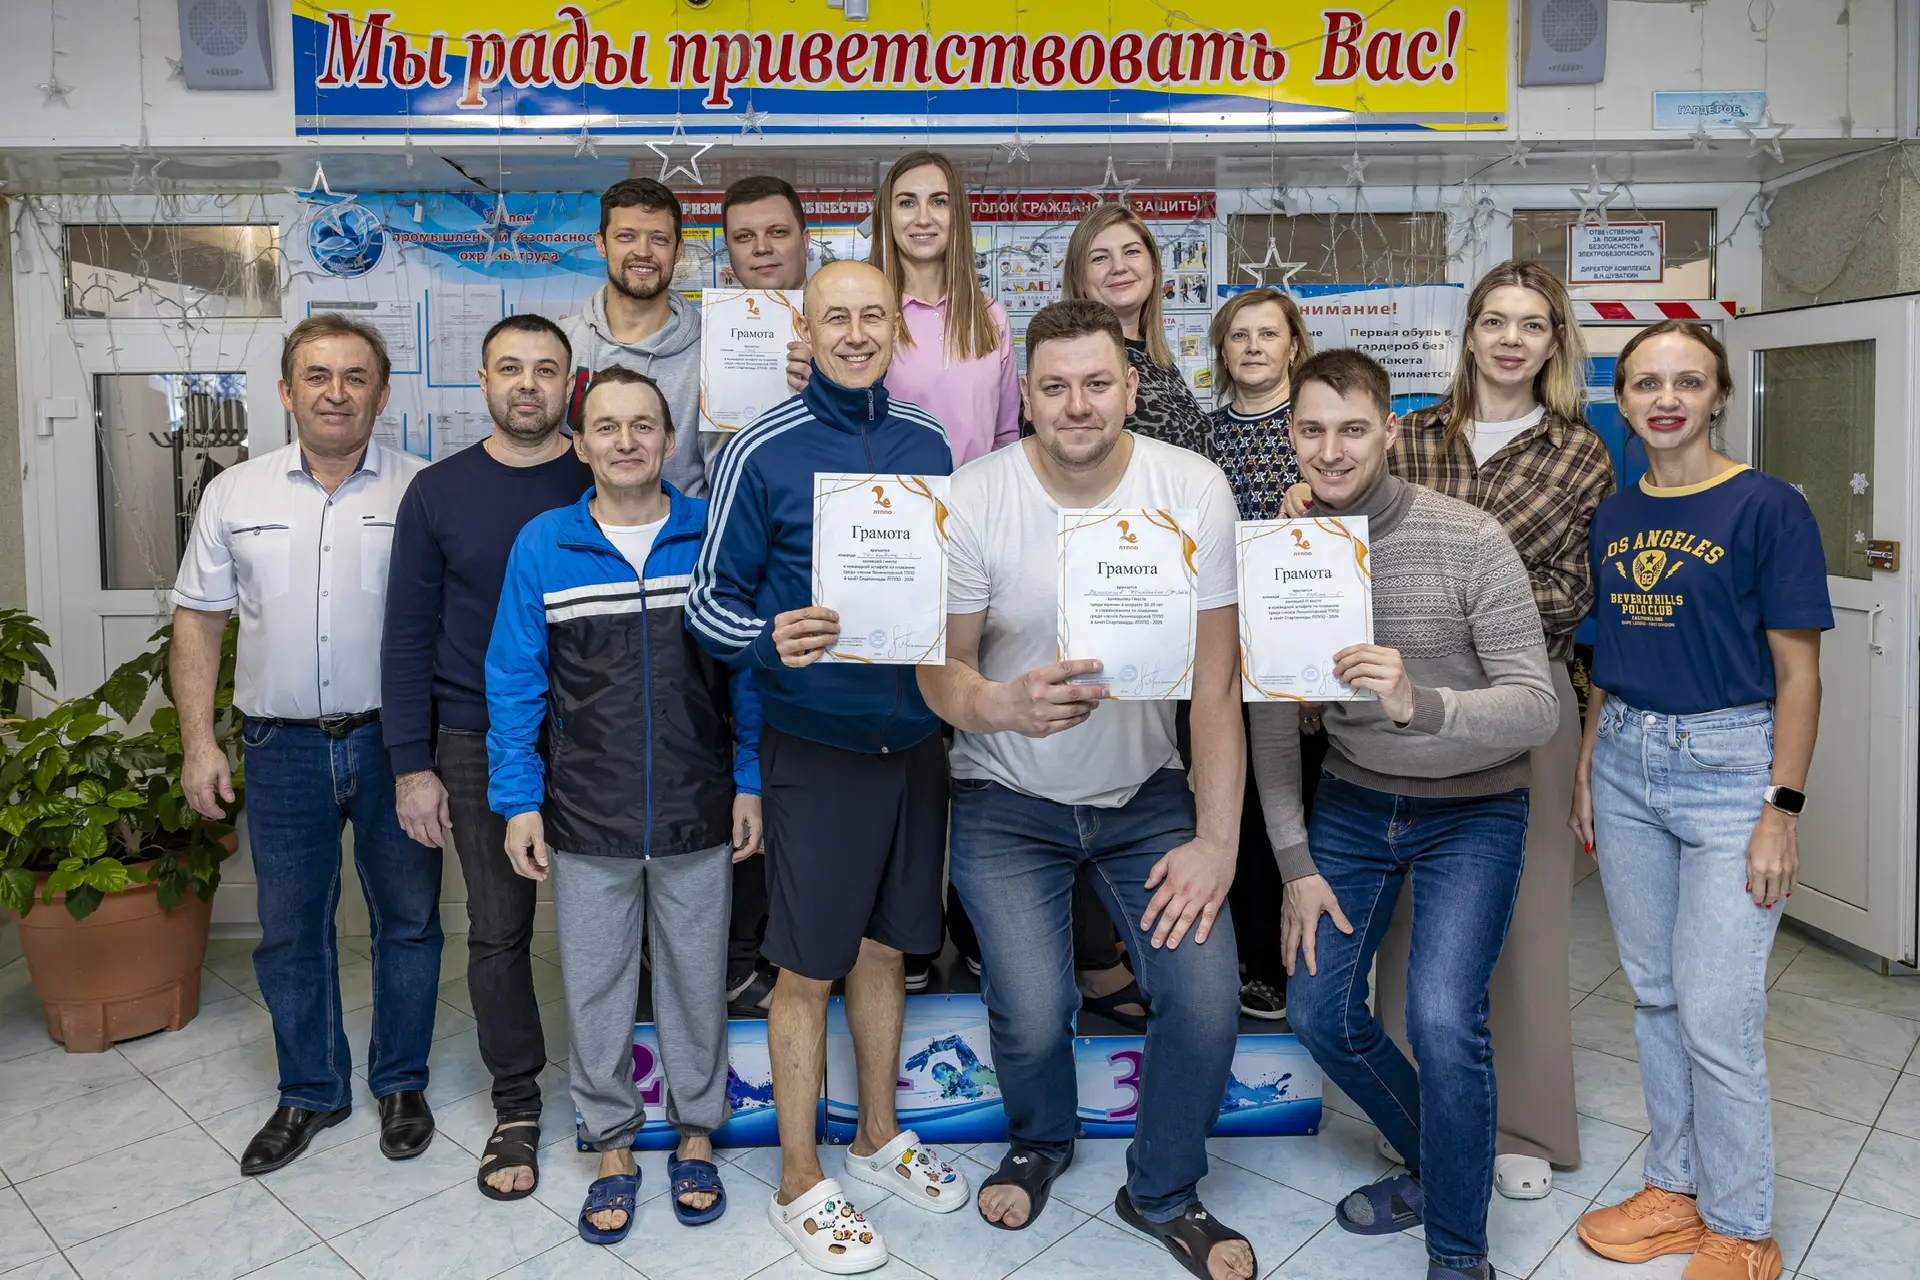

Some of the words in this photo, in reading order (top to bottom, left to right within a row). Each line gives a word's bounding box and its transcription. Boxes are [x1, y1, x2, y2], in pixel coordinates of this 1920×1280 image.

[319, 11, 453, 85] Мы
[459, 6, 652, 107] рады
[667, 30, 1288, 106] приветствовать
[1314, 9, 1463, 84] Вас!
[1678, 105, 1741, 115] ГАРДЕРОБ
[802, 202, 874, 214] БЩЕСТВУ
[968, 202, 1018, 213] ГОЛОК
[1135, 200, 1200, 213] ЗАЩИТЫ
[392, 230, 508, 244] промышленнй
[1300, 302, 1397, 315] нимание!
[731, 328, 774, 340] Грамота
[1350, 328, 1398, 338] Первая
[1402, 328, 1441, 339] обувь
[1357, 341, 1419, 352] гардероб
[1422, 342, 1445, 350] без
[1379, 357, 1423, 365] пакета
[852, 525, 911, 542] Грамота
[1632, 530, 1725, 565] ANGELES
[1097, 562, 1158, 579] Грамота
[1274, 567, 1332, 583] Грамота
[1641, 572, 1653, 585] 82
[1610, 593, 1653, 605] BEVERLY
[1654, 594, 1684, 606] HILLS
[1622, 604, 1647, 615] POLO
[1648, 605, 1673, 616] CLUB
[1106, 1048, 1143, 1122] 3
